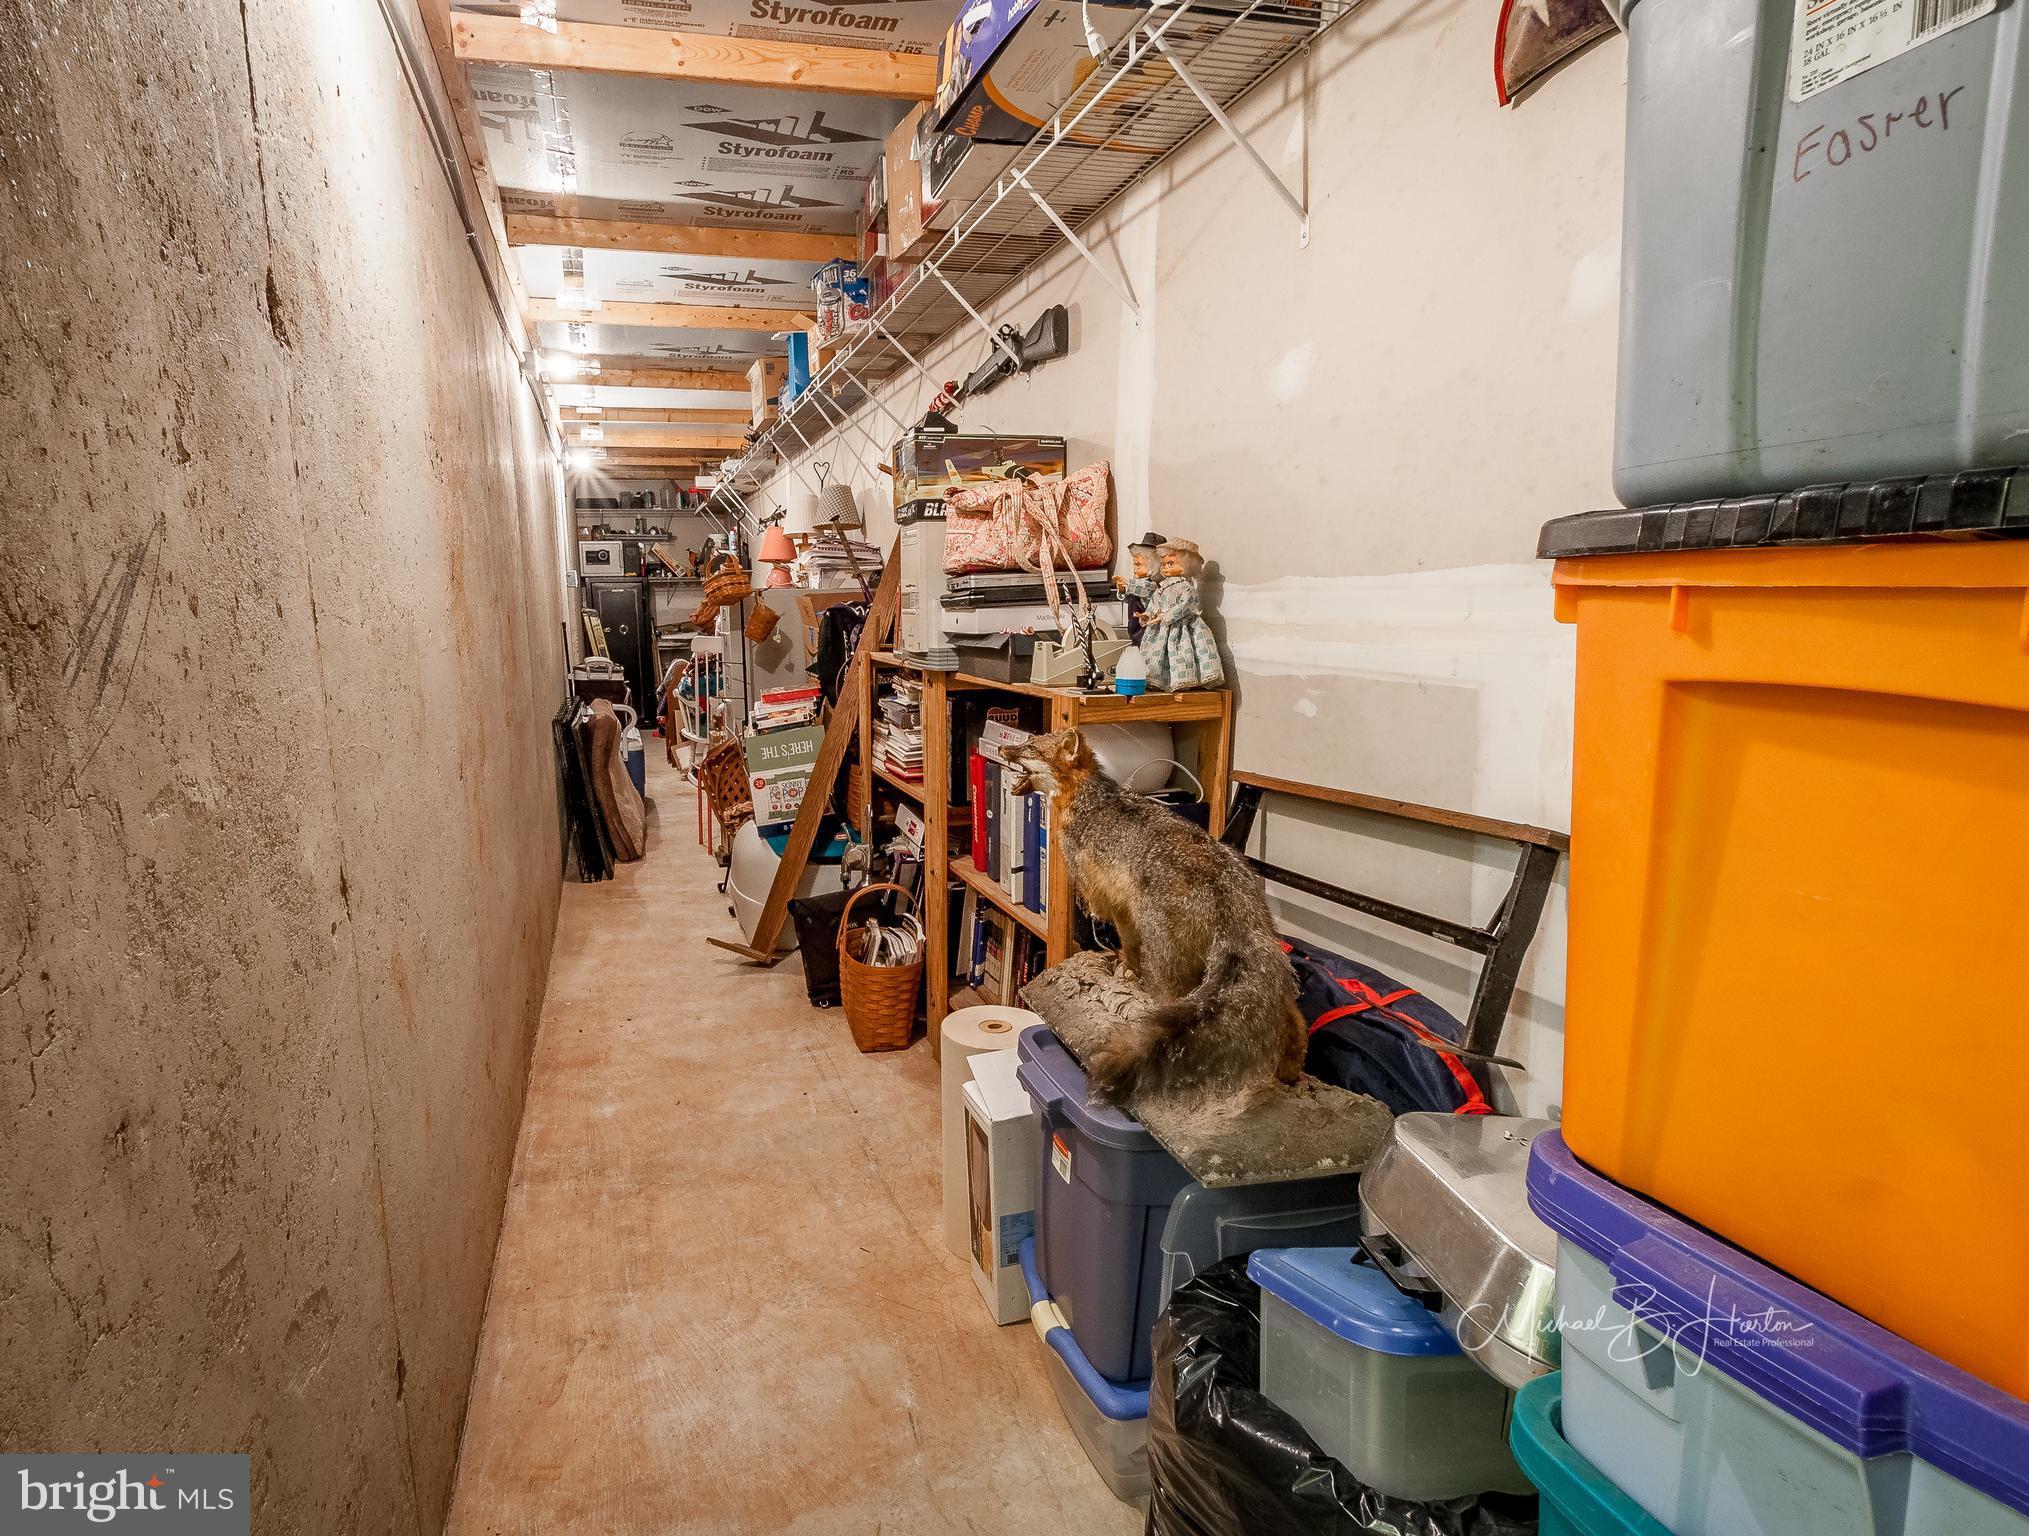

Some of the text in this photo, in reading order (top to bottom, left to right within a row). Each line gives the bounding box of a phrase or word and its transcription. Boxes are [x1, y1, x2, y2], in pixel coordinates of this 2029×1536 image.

[750, 0, 900, 33] Styrofoam
[1803, 48, 1813, 59] 24
[1815, 41, 1825, 52] IN
[1826, 37, 1833, 46] X
[1836, 33, 1845, 41] 16
[1847, 26, 1857, 36] IN
[1859, 20, 1866, 30] X
[1892, 2, 1903, 13] IN
[902, 45, 924, 55] R5
[1803, 48, 1831, 67] 18 GAL
[693, 105, 722, 113] DOW
[717, 141, 834, 162] Styrofoam
[703, 206, 803, 221] Styrofoam
[843, 268, 857, 278] 36
[684, 282, 767, 294] Styrofoam
[760, 739, 814, 761] HERE'S THE
[781, 779, 803, 790] SKINNY
[782, 787, 804, 799] POP
